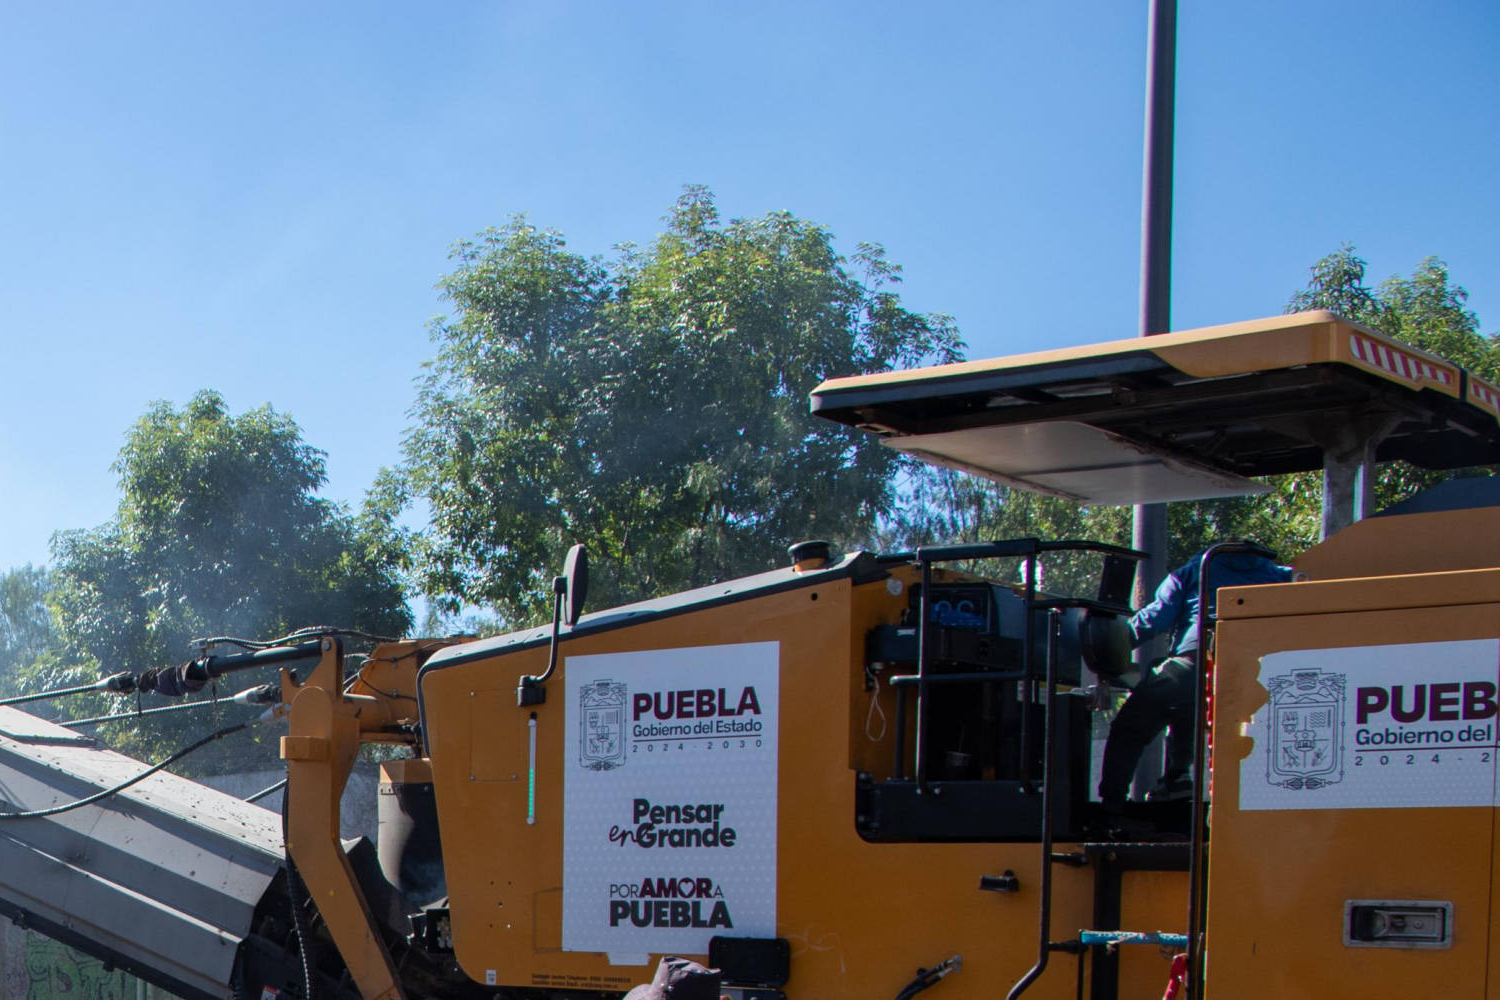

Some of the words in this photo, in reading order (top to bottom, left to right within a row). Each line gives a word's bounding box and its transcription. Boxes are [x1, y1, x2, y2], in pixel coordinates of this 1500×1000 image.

[632, 686, 762, 721] PUEBLA
[633, 722, 692, 738] Gobierno
[693, 720, 714, 734] del
[715, 717, 762, 733] Estado
[1355, 726, 1455, 746] Gobierno
[1457, 723, 1492, 743] del
[633, 798, 725, 825] Pensar
[608, 824, 638, 848] en
[636, 821, 737, 849] Grande
[609, 883, 640, 899] POR
[639, 877, 713, 899] AMOR
[713, 885, 725, 899] A
[609, 900, 734, 929] PUEBLA
